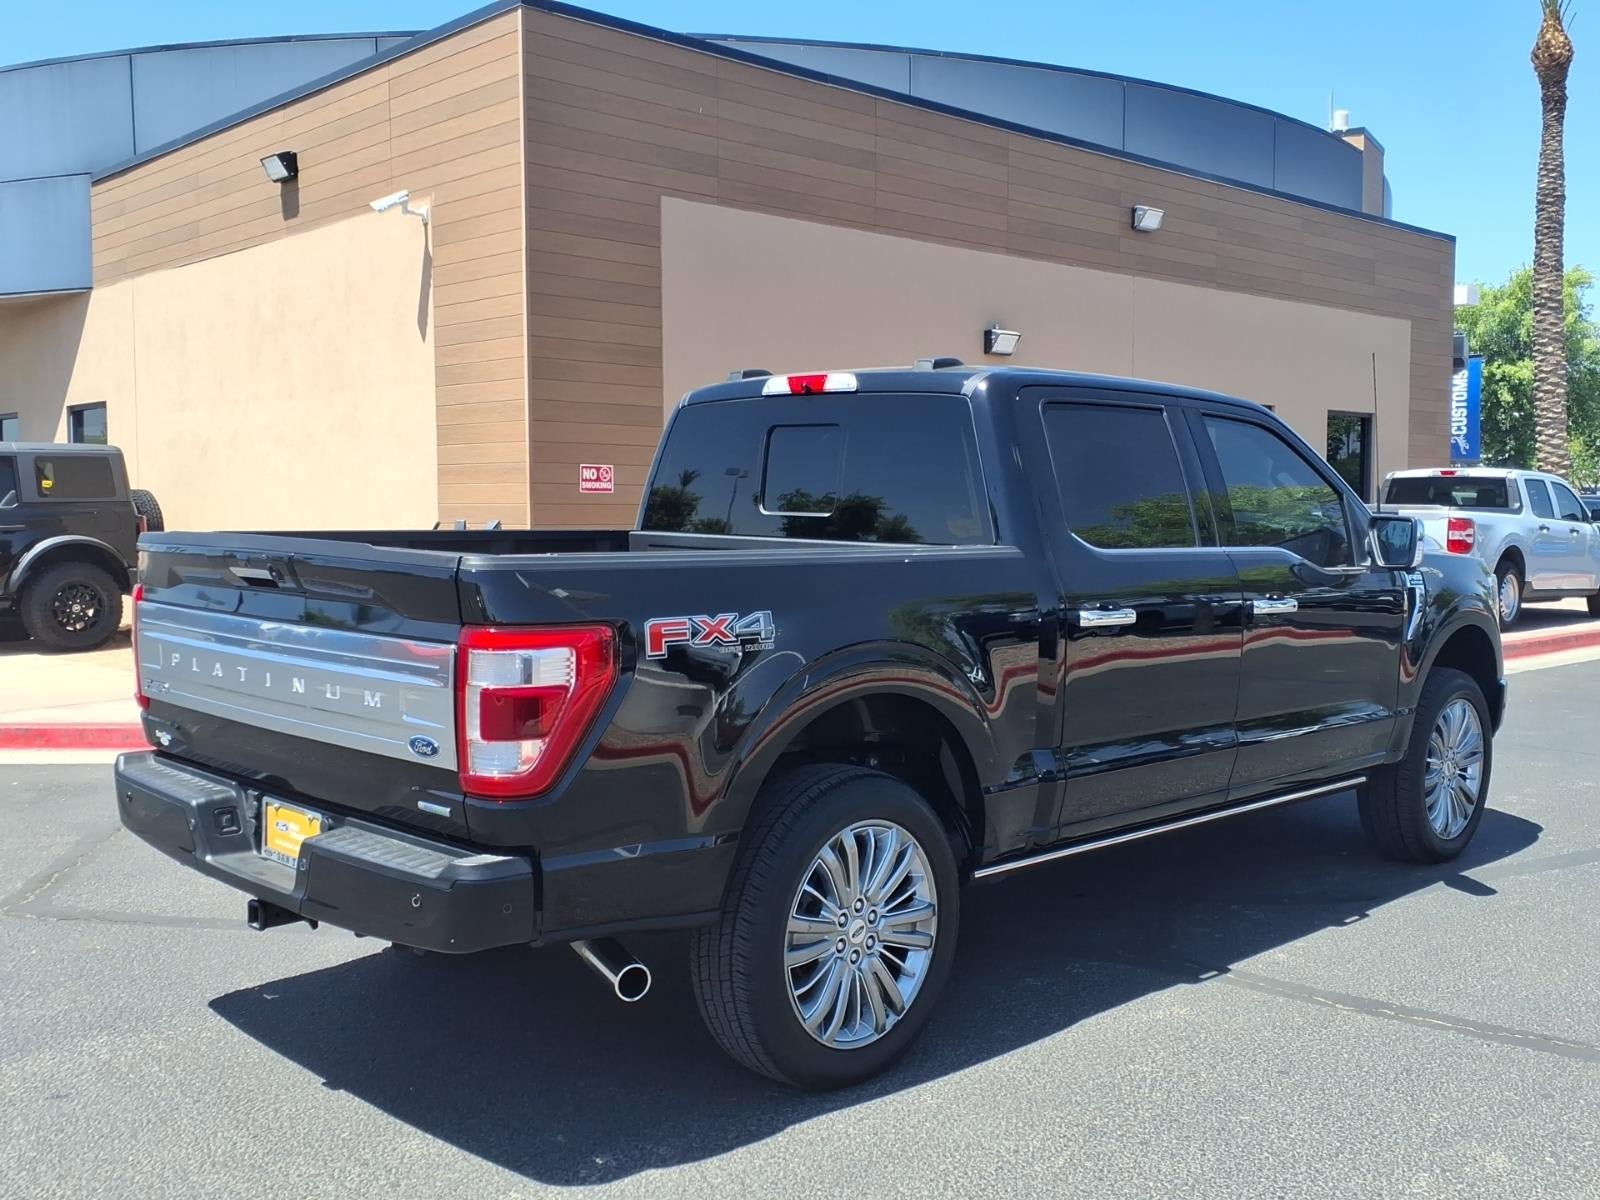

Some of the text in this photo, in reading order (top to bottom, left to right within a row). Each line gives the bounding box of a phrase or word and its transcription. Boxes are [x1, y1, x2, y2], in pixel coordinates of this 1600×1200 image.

[1451, 368, 1469, 435] CUSTOMS
[581, 481, 612, 489] SMOKING
[582, 467, 598, 480] NO
[644, 611, 775, 659] FX4
[171, 652, 382, 708] PLATINUM
[412, 738, 435, 757] Ford
